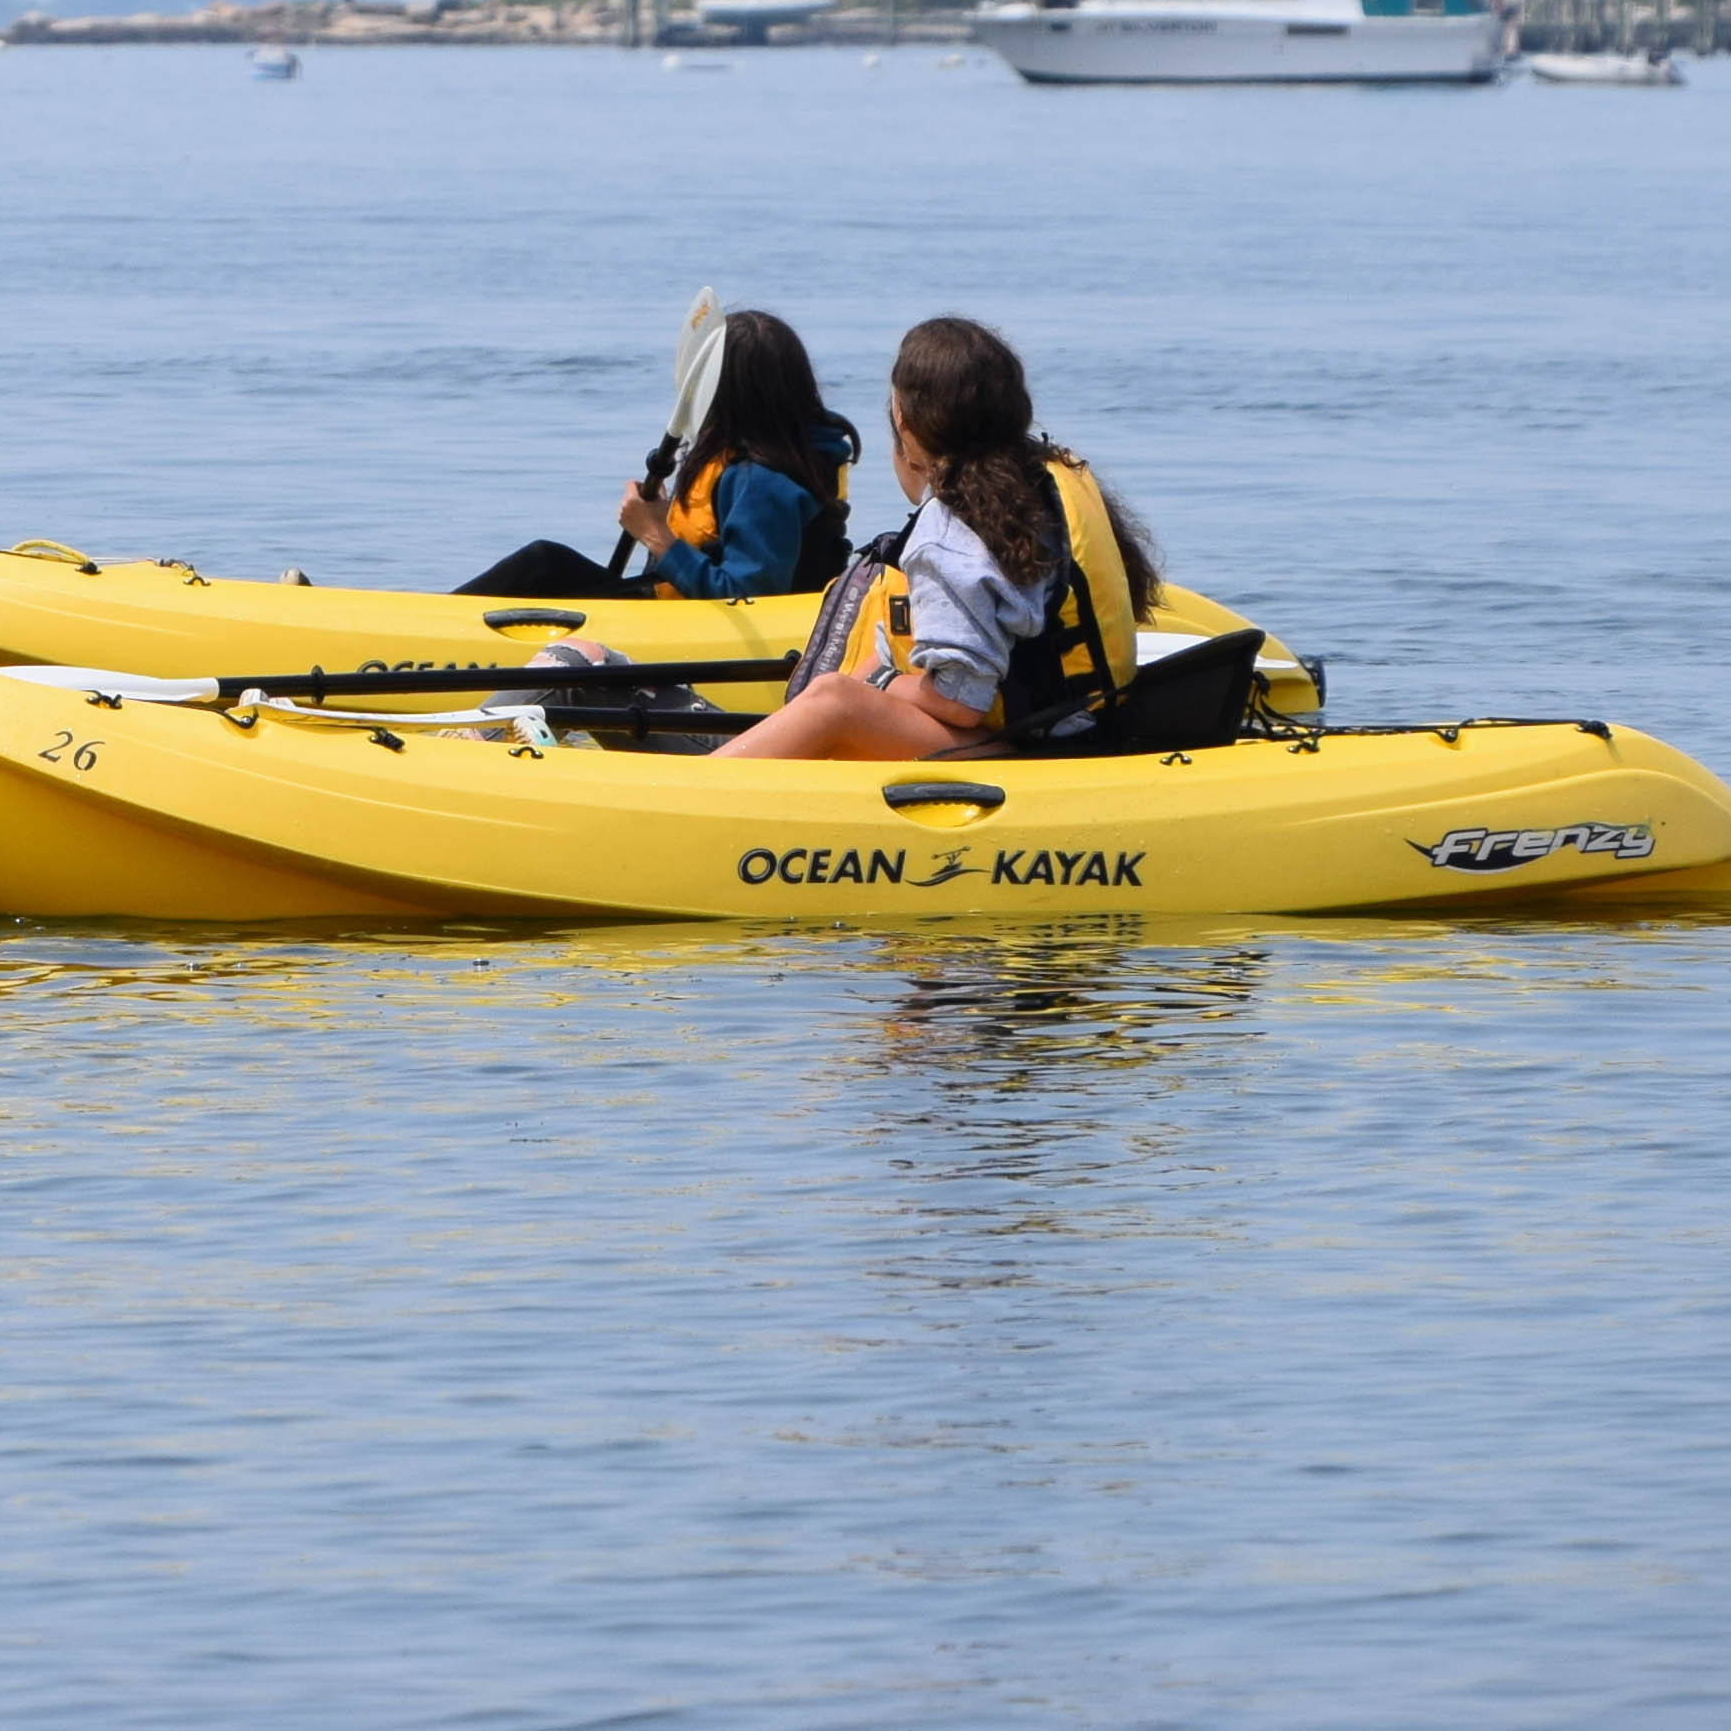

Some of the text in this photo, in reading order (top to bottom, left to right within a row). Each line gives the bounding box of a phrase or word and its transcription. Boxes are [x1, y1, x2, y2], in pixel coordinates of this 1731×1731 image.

[37, 730, 106, 772] 26
[737, 848, 1146, 886] OCEAN KAYAK
[1432, 827, 1655, 868] Frenzy
